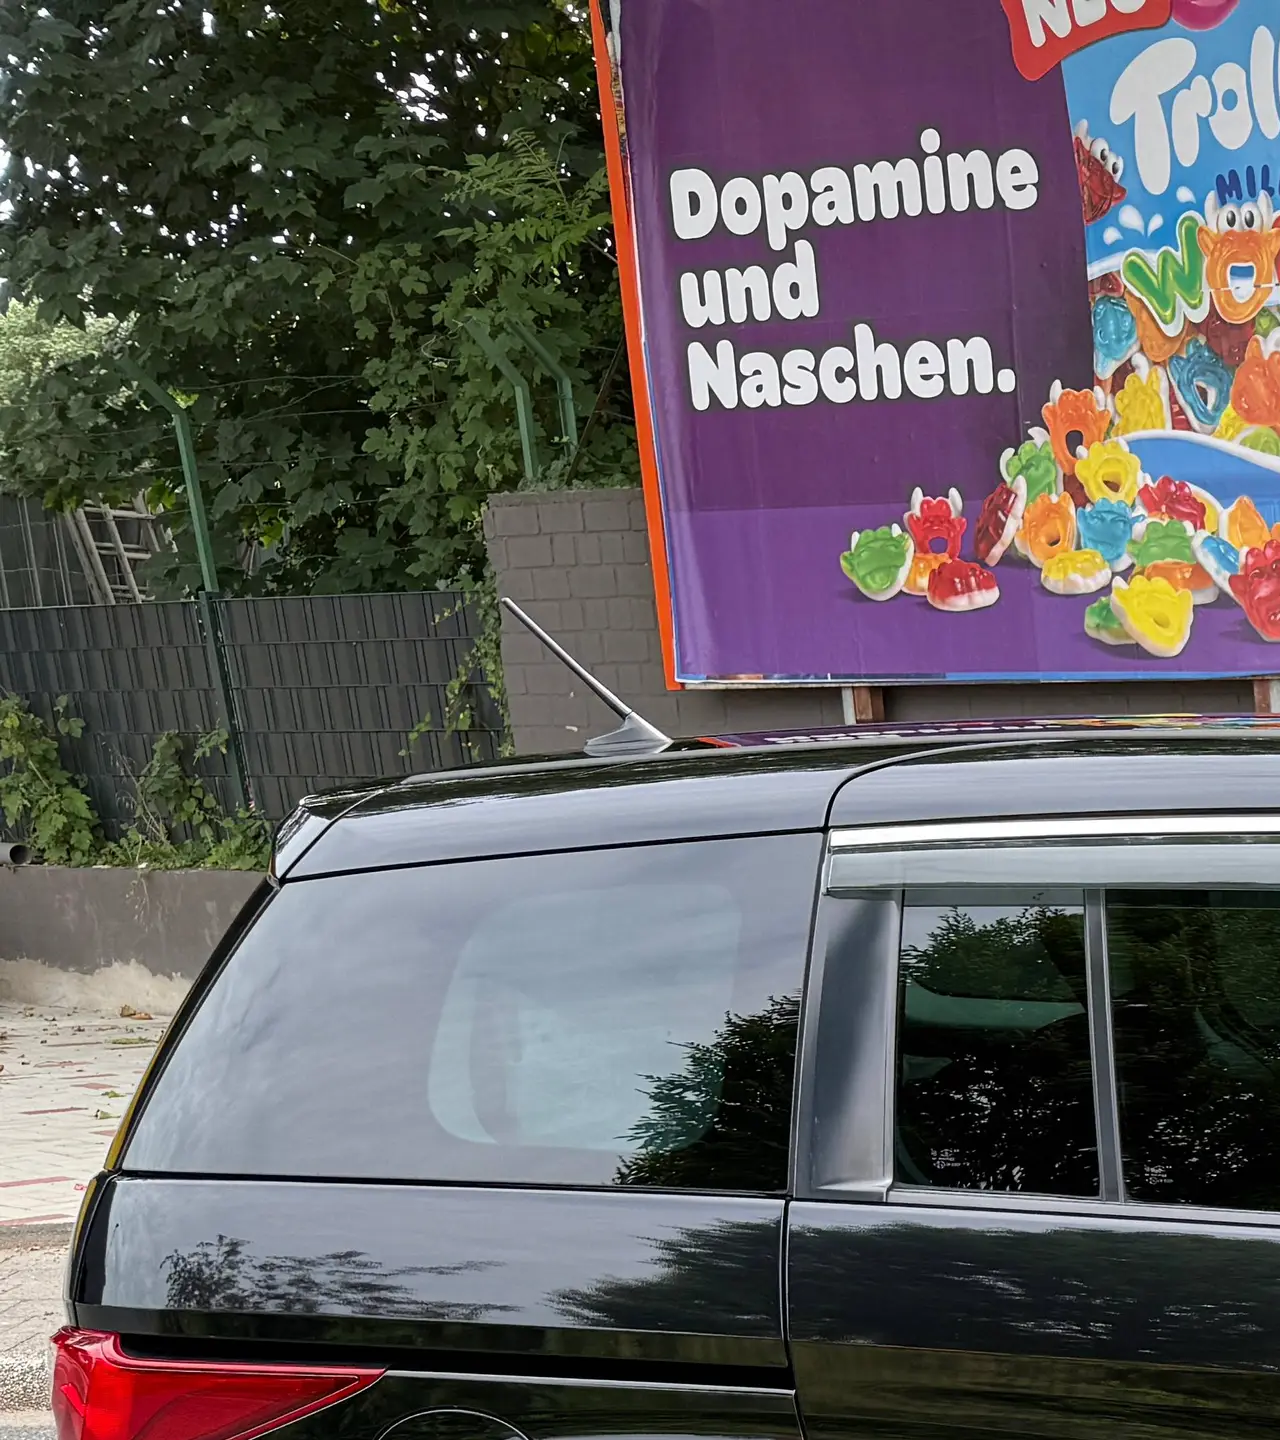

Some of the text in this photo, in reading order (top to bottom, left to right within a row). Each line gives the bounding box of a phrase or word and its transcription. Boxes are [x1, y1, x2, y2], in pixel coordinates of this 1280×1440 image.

[669, 128, 1039, 251] Dopamine
[680, 239, 819, 328] und
[687, 323, 1016, 411] Naschen.
